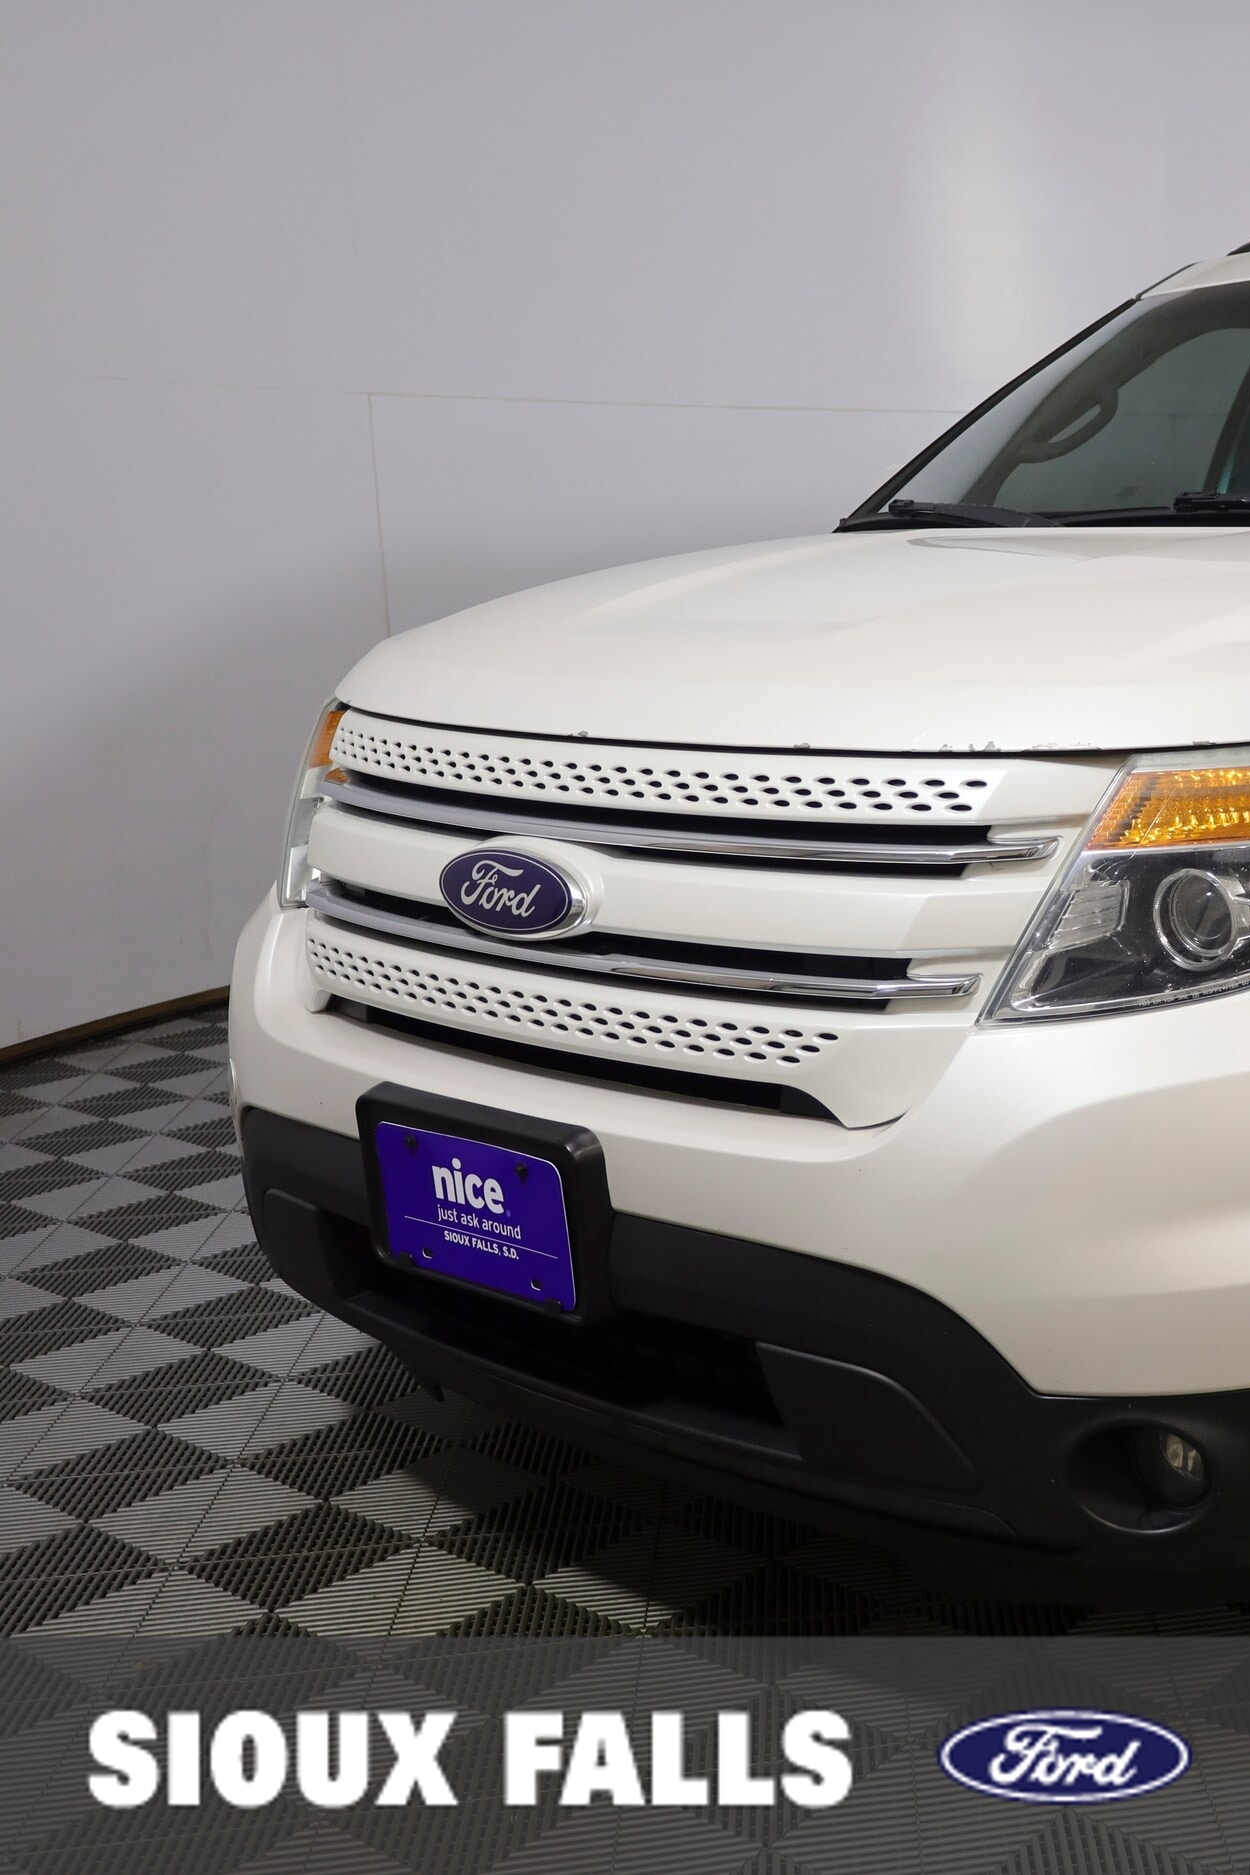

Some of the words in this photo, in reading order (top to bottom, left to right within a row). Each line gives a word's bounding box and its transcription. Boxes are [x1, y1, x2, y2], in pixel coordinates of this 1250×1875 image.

[460, 859, 542, 918] Ford
[431, 1157, 505, 1215] nice
[438, 1204, 458, 1222] just
[461, 1213, 480, 1228] ask
[482, 1219, 521, 1239] around
[444, 1231, 470, 1247] SIOUX
[472, 1238, 501, 1256] FALLS,
[503, 1247, 519, 1260] S.D.
